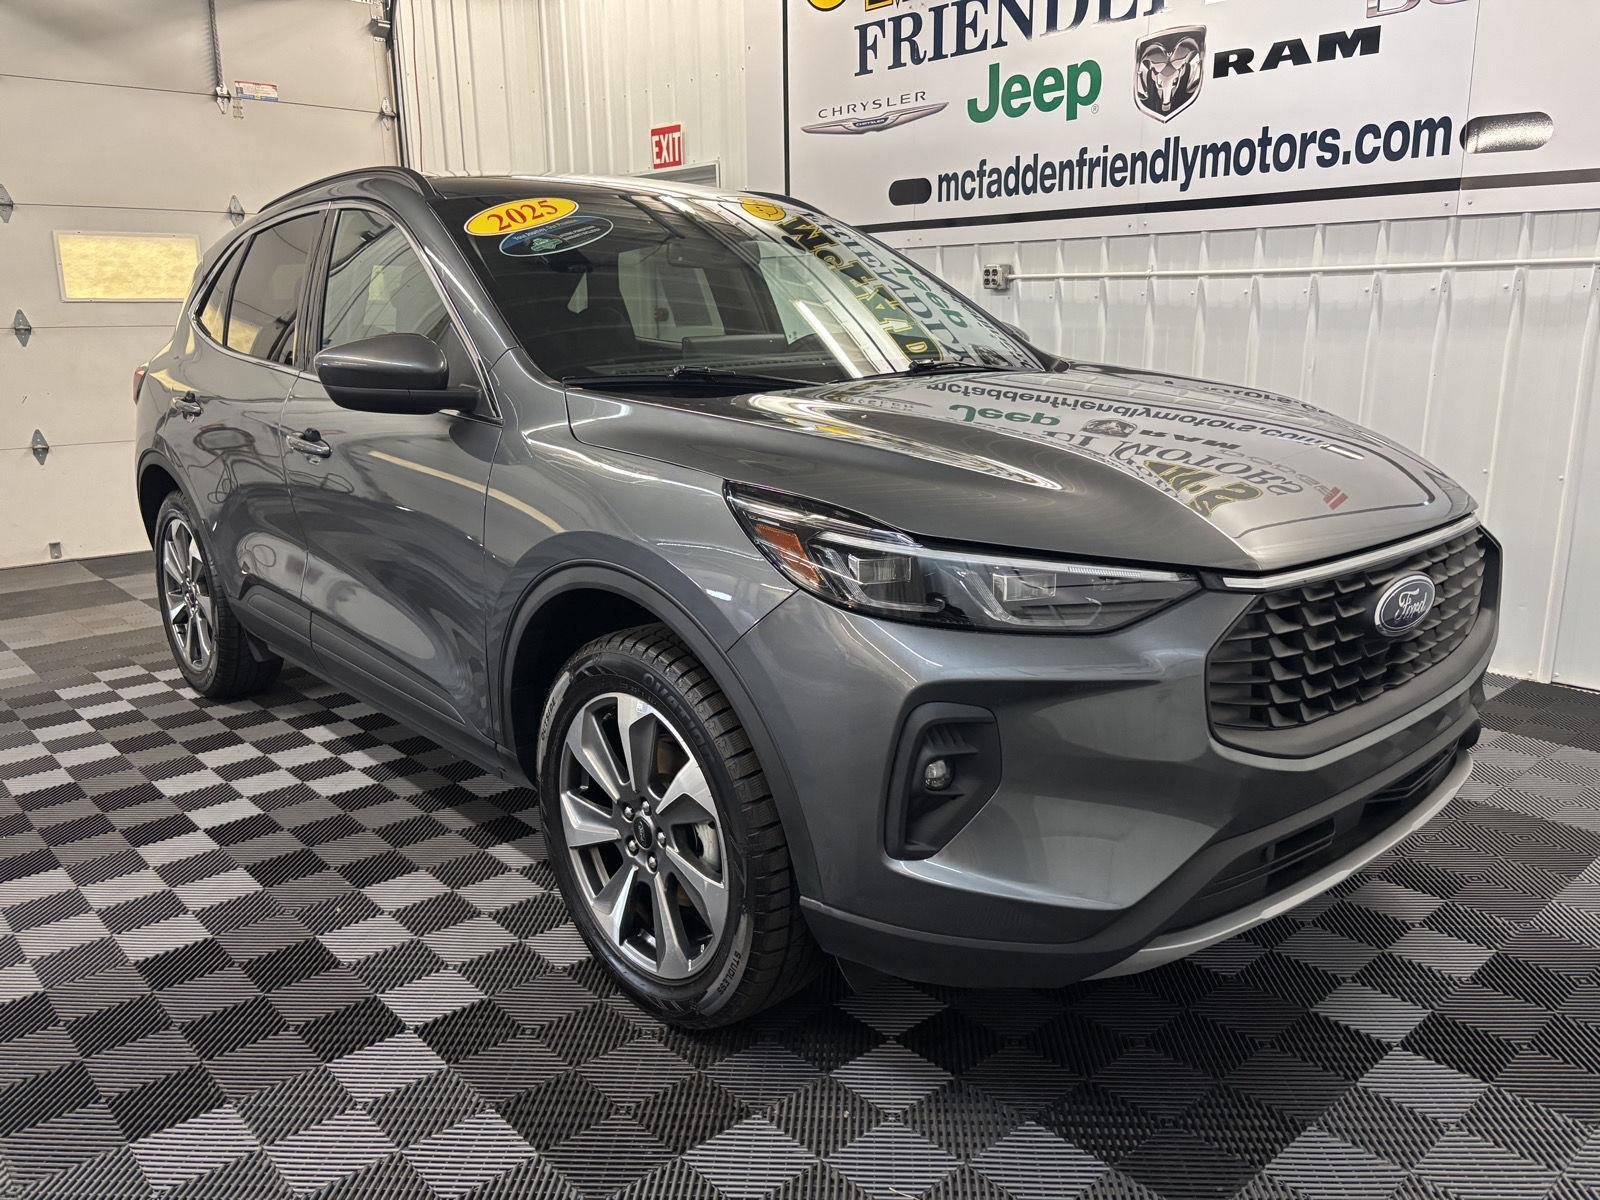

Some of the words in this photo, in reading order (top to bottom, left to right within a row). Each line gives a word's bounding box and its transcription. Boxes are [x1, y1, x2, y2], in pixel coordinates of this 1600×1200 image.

[853, 0, 1165, 77] FRIENDL
[1213, 25, 1381, 79] RAM
[818, 91, 926, 119] CHRYSLER
[967, 59, 1101, 123] Jeep
[651, 132, 681, 164] EXIT
[937, 115, 1452, 202] mcfaddenfriendlymotors.com
[487, 200, 558, 231] 2025
[1394, 588, 1427, 621] Ford
[717, 950, 741, 995] STUDLESS
